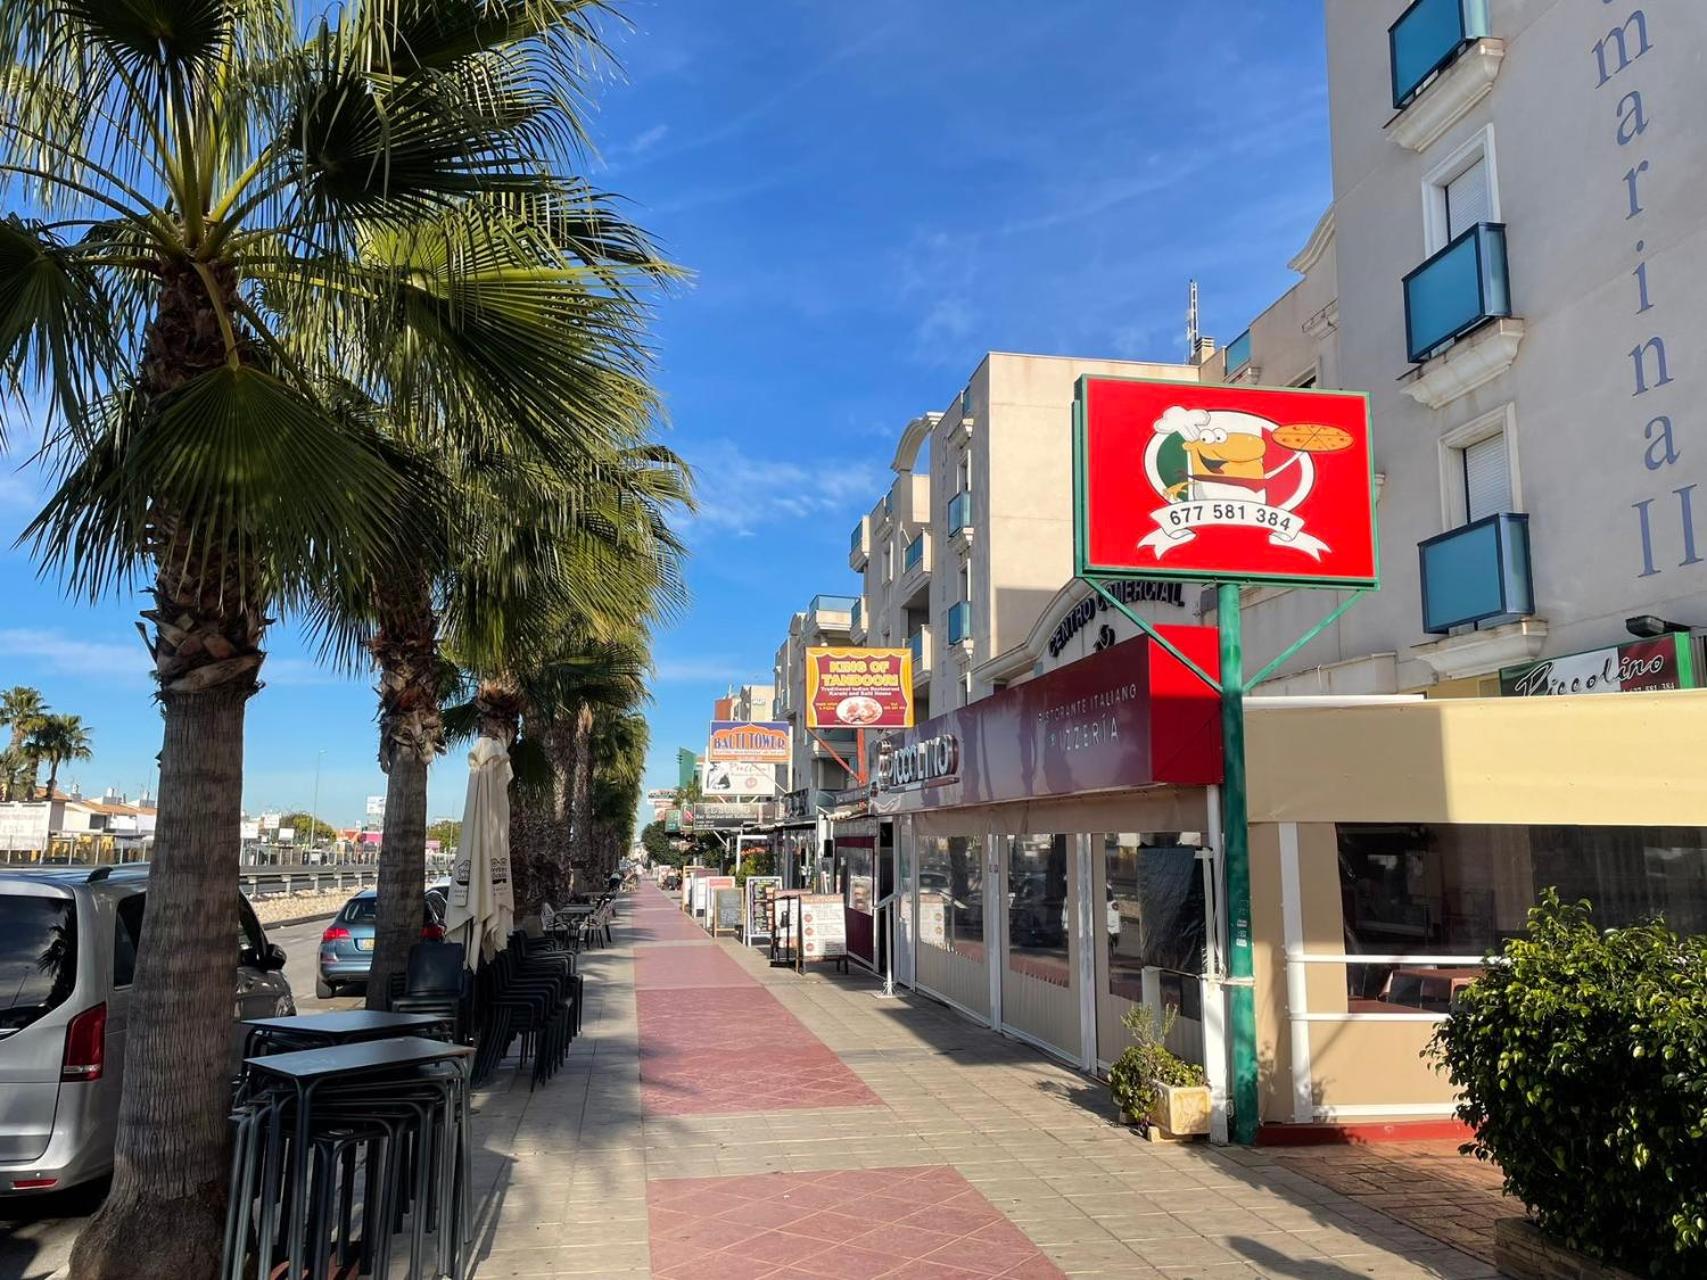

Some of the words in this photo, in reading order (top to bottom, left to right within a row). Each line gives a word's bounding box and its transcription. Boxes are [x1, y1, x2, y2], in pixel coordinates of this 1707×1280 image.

[1590, 8, 1682, 473] marina
[1169, 505, 1203, 526] 677
[1213, 504, 1245, 520] 581
[1256, 508, 1291, 532] 384
[1048, 597, 1096, 658] CENTRO
[821, 674, 899, 687] TANDOORI
[829, 660, 867, 673] KING
[869, 660, 890, 673] OF
[1514, 654, 1665, 696] Piccolino
[1038, 698, 1086, 721] RISTORANTE
[1091, 683, 1137, 709] ITALIANO
[714, 733, 745, 750] BALTI
[748, 732, 785, 750] TOWER
